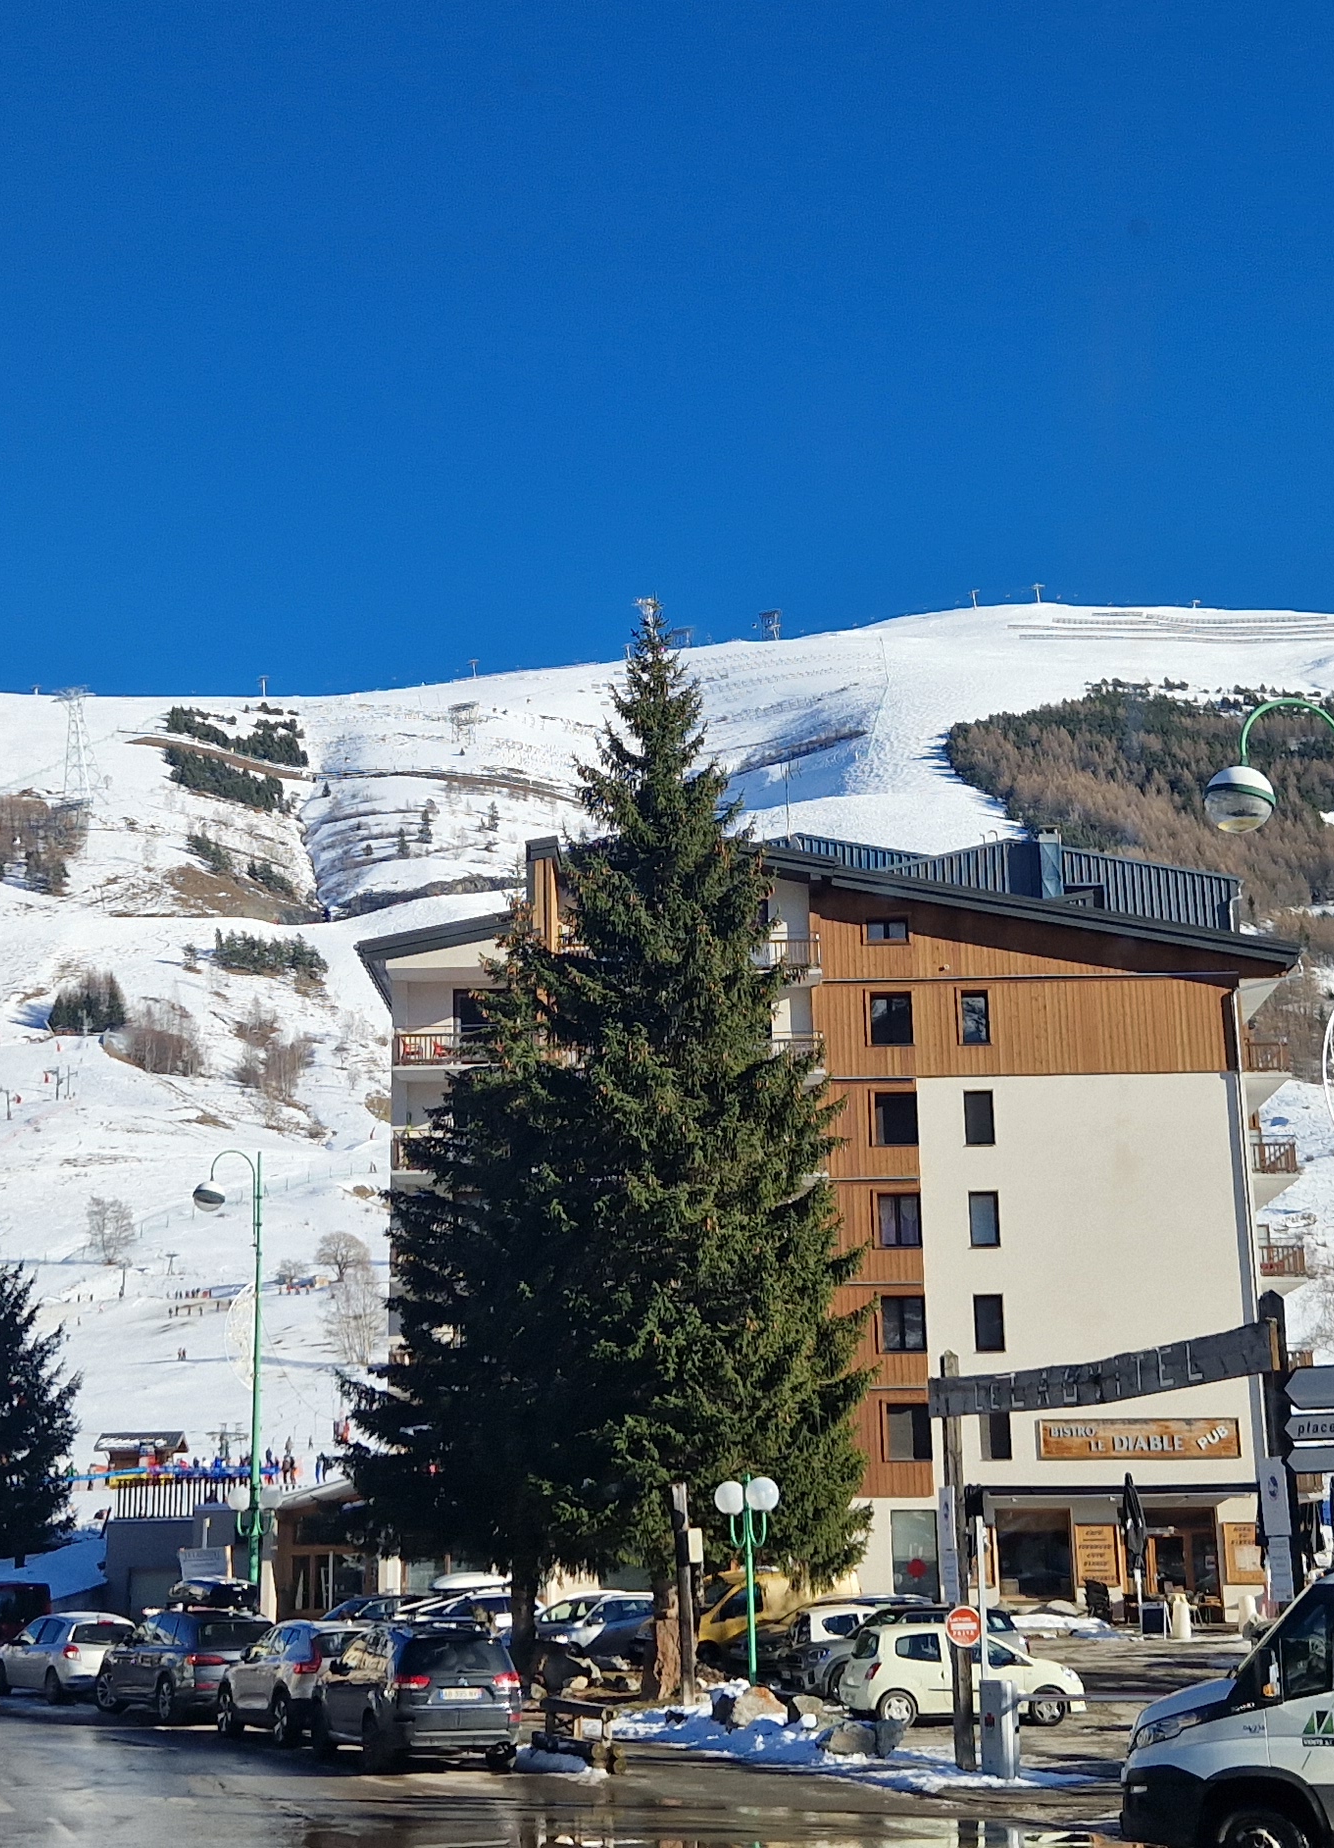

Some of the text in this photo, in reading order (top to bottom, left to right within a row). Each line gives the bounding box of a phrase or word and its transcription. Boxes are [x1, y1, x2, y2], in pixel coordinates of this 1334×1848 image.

[1048, 1425, 1097, 1438] BISTRO
[1196, 1424, 1229, 1450] PUB
[1089, 1434, 1184, 1452] LE DIABLE
